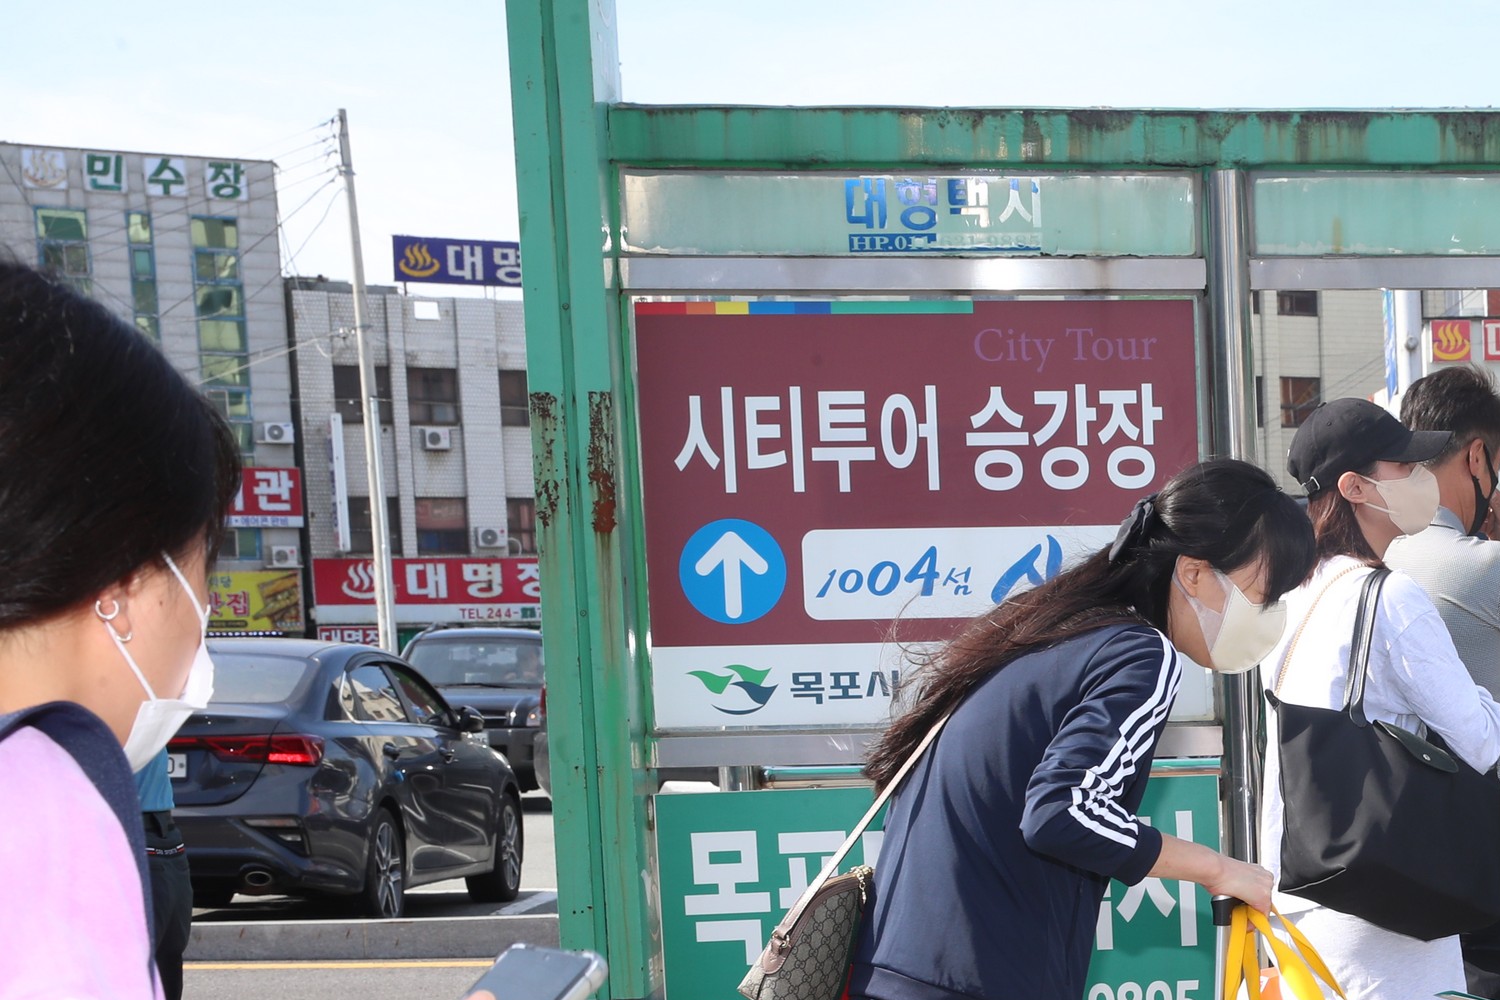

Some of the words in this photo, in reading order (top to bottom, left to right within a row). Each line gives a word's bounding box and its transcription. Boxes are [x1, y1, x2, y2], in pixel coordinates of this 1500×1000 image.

[86, 153, 245, 200] 민수장
[844, 178, 1042, 231] 대형택시
[973, 328, 1055, 373] City
[1065, 327, 1158, 361] Tour
[674, 384, 941, 493] 시티투어
[965, 383, 1164, 490] 승강장
[459, 608, 484, 620] TEL
[789, 669, 901, 704] 목포시
